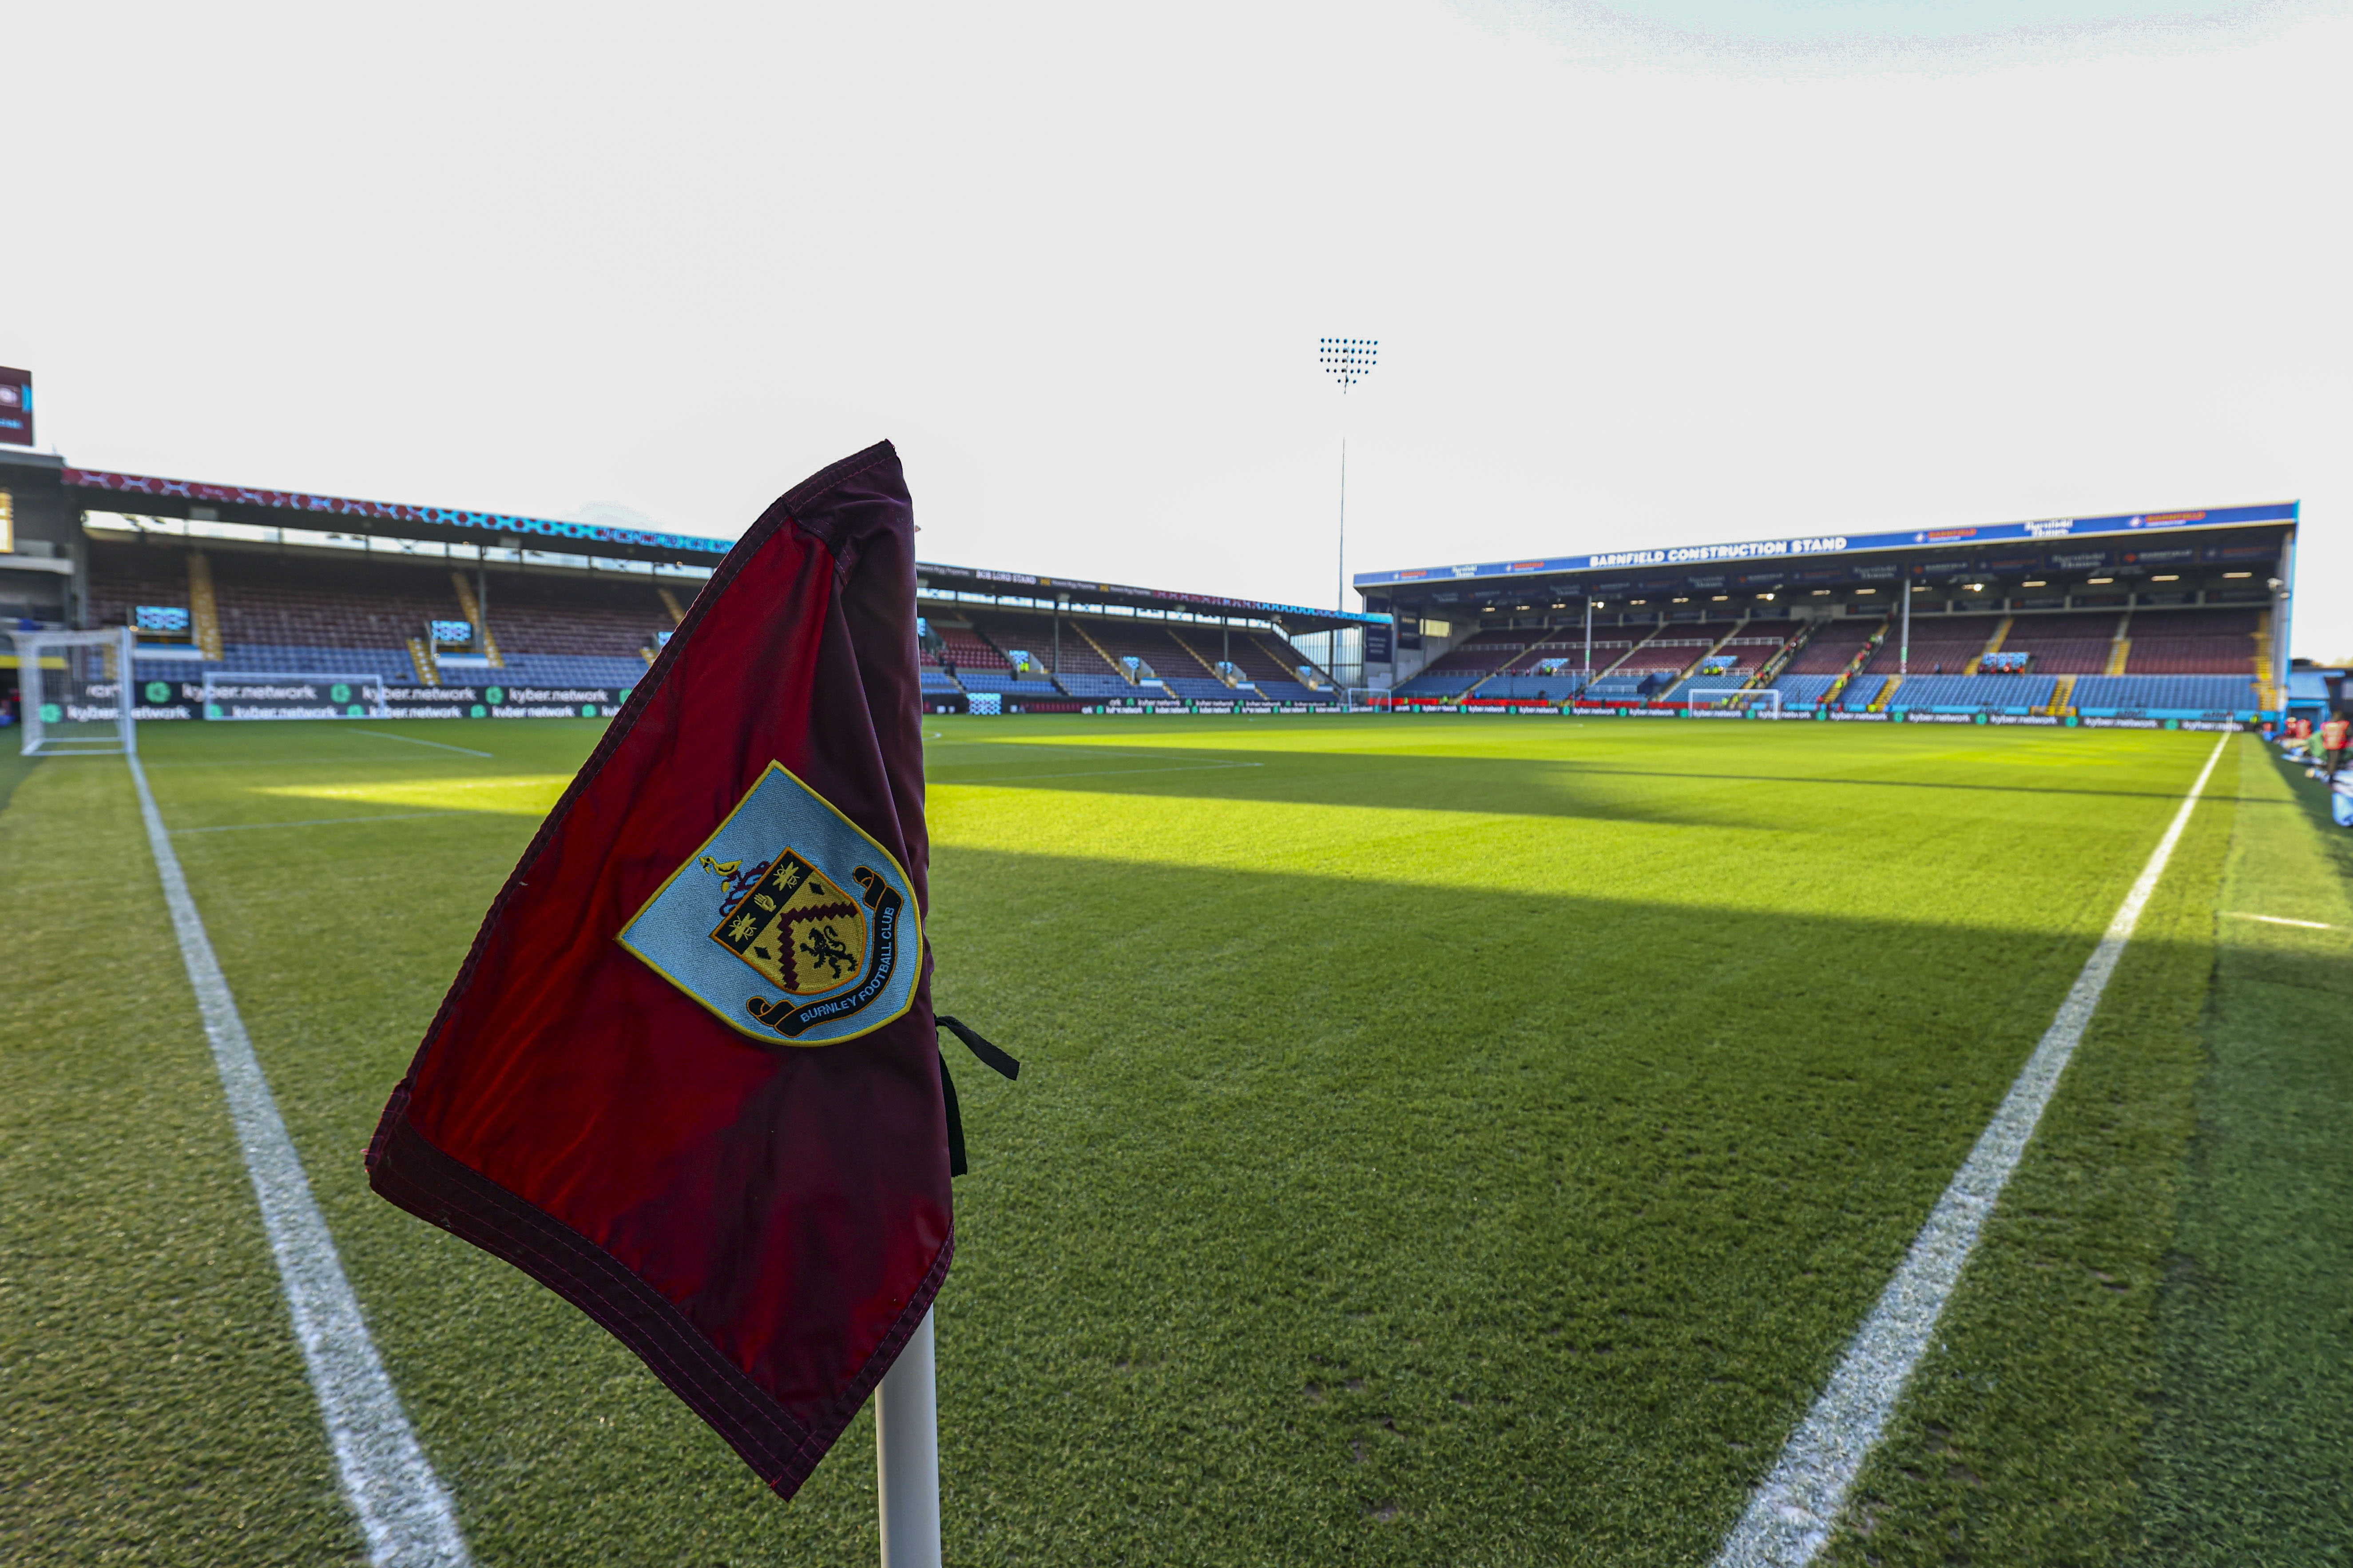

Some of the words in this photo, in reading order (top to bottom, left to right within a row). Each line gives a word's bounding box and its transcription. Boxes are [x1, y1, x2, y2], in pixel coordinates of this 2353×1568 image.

[1589, 550, 1666, 567] BARNFIELD
[1667, 540, 1787, 561] CONSTRUCTION
[1790, 536, 1848, 554] STAND
[992, 571, 1012, 583] LORD
[1012, 573, 1036, 585] STAND
[182, 683, 318, 703] kyber.network
[362, 685, 477, 703] kyber.network
[509, 687, 609, 704] kyber.network
[1829, 711, 1888, 721] kyber.network
[1908, 712, 1971, 723] kyber.network
[1990, 714, 2058, 725] kyber.network
[2083, 717, 2159, 729] kyber.network
[799, 995, 858, 1023] BURNLEY
[857, 942, 892, 1002] FOOTBALL
[881, 906, 895, 940] CLUB
